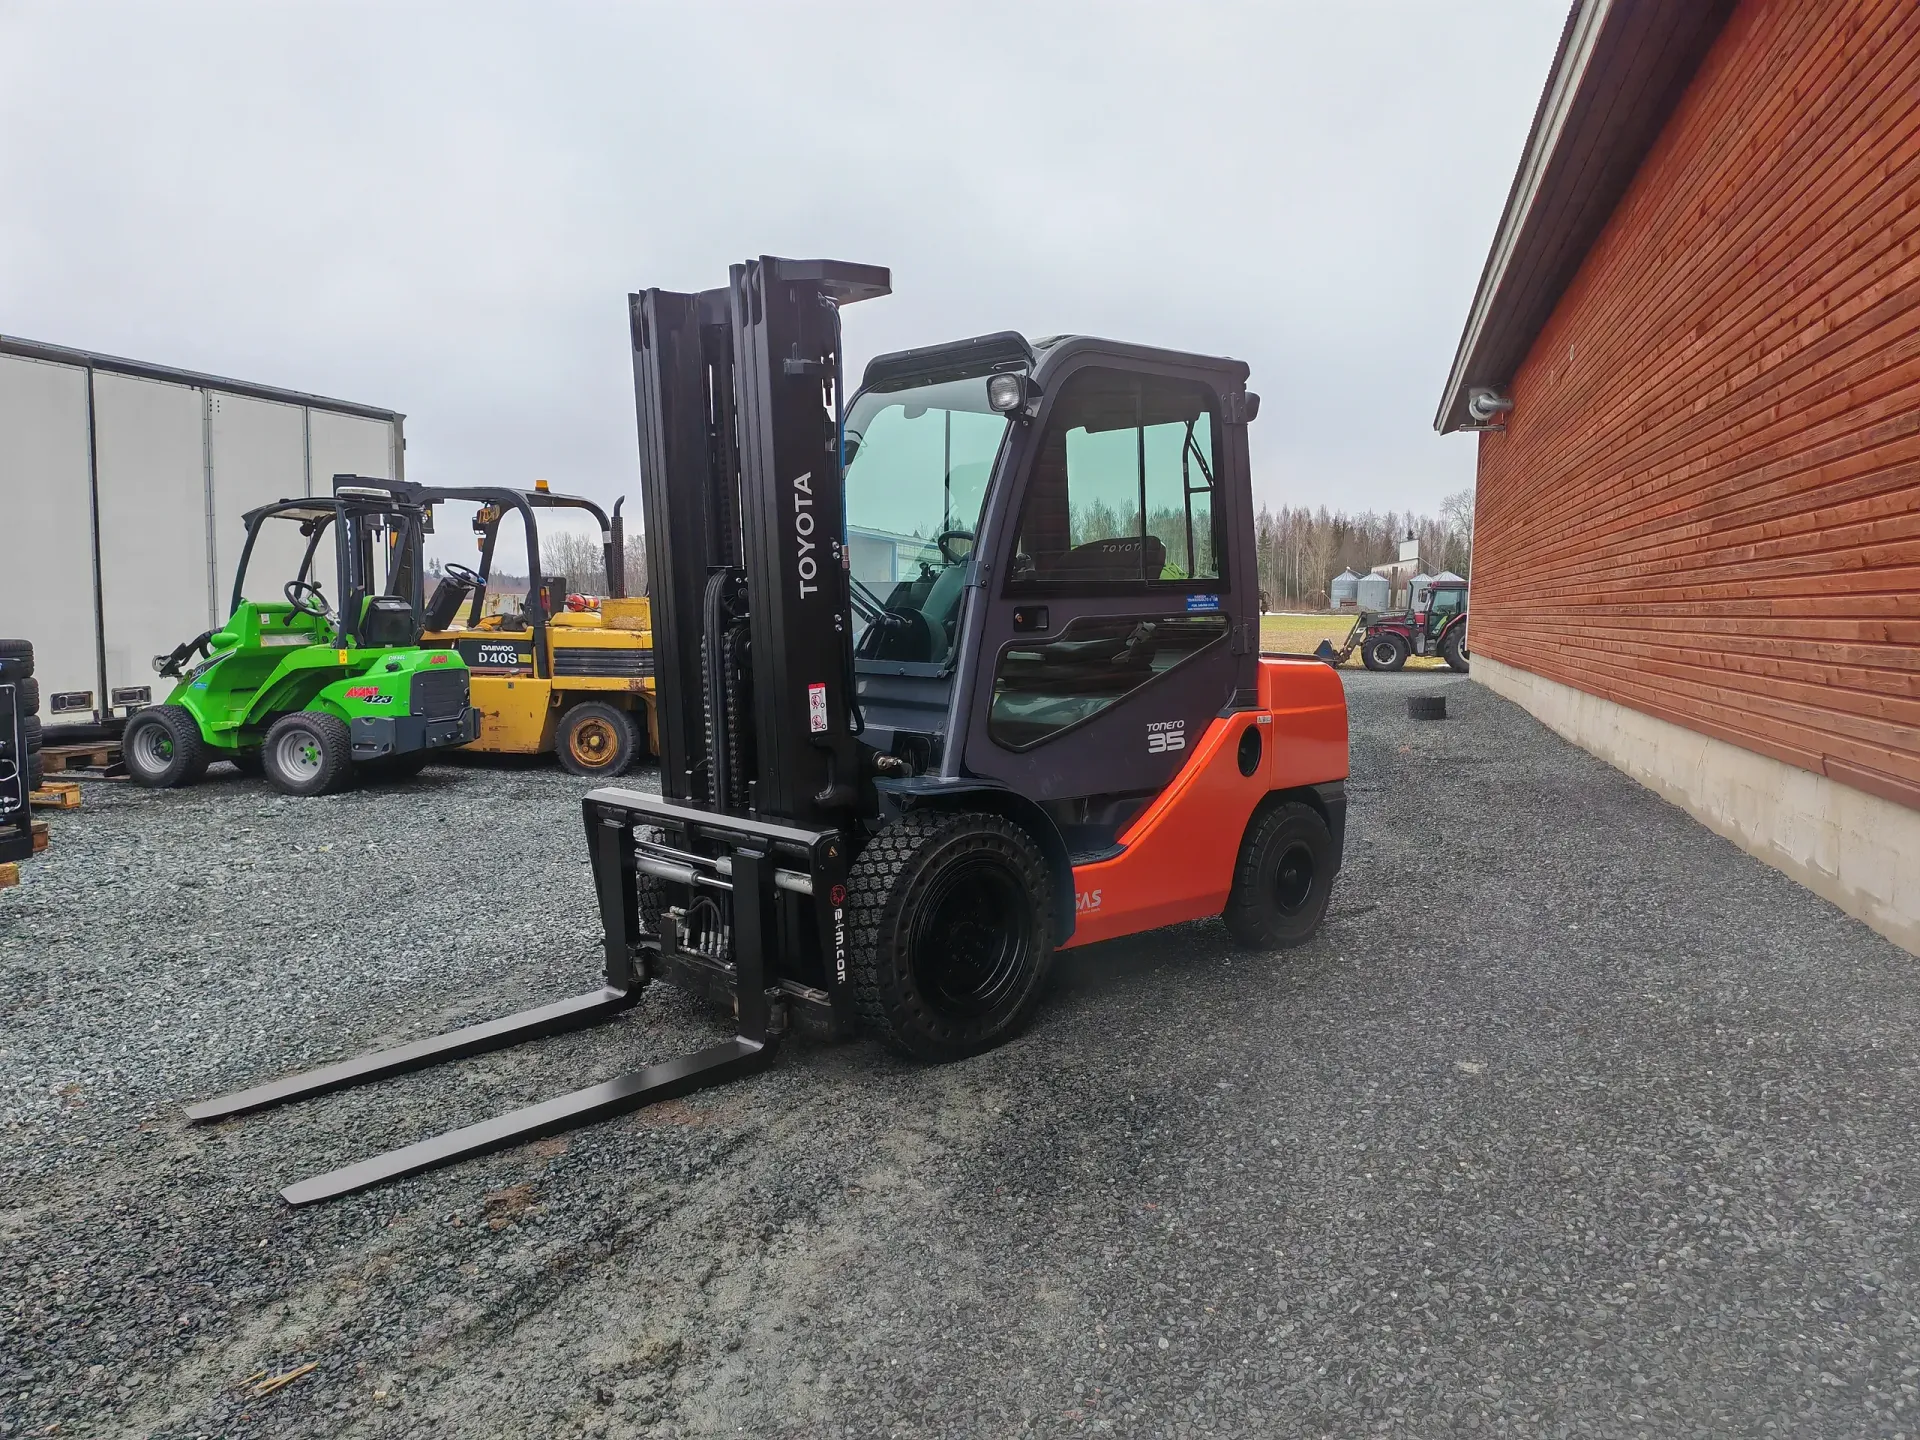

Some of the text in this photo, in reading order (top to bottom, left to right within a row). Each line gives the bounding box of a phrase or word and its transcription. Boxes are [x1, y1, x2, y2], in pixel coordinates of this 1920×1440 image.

[794, 471, 818, 599] TOYOTA
[344, 687, 379, 698] AVANT
[363, 695, 393, 704] 423
[1147, 730, 1186, 753] 35
